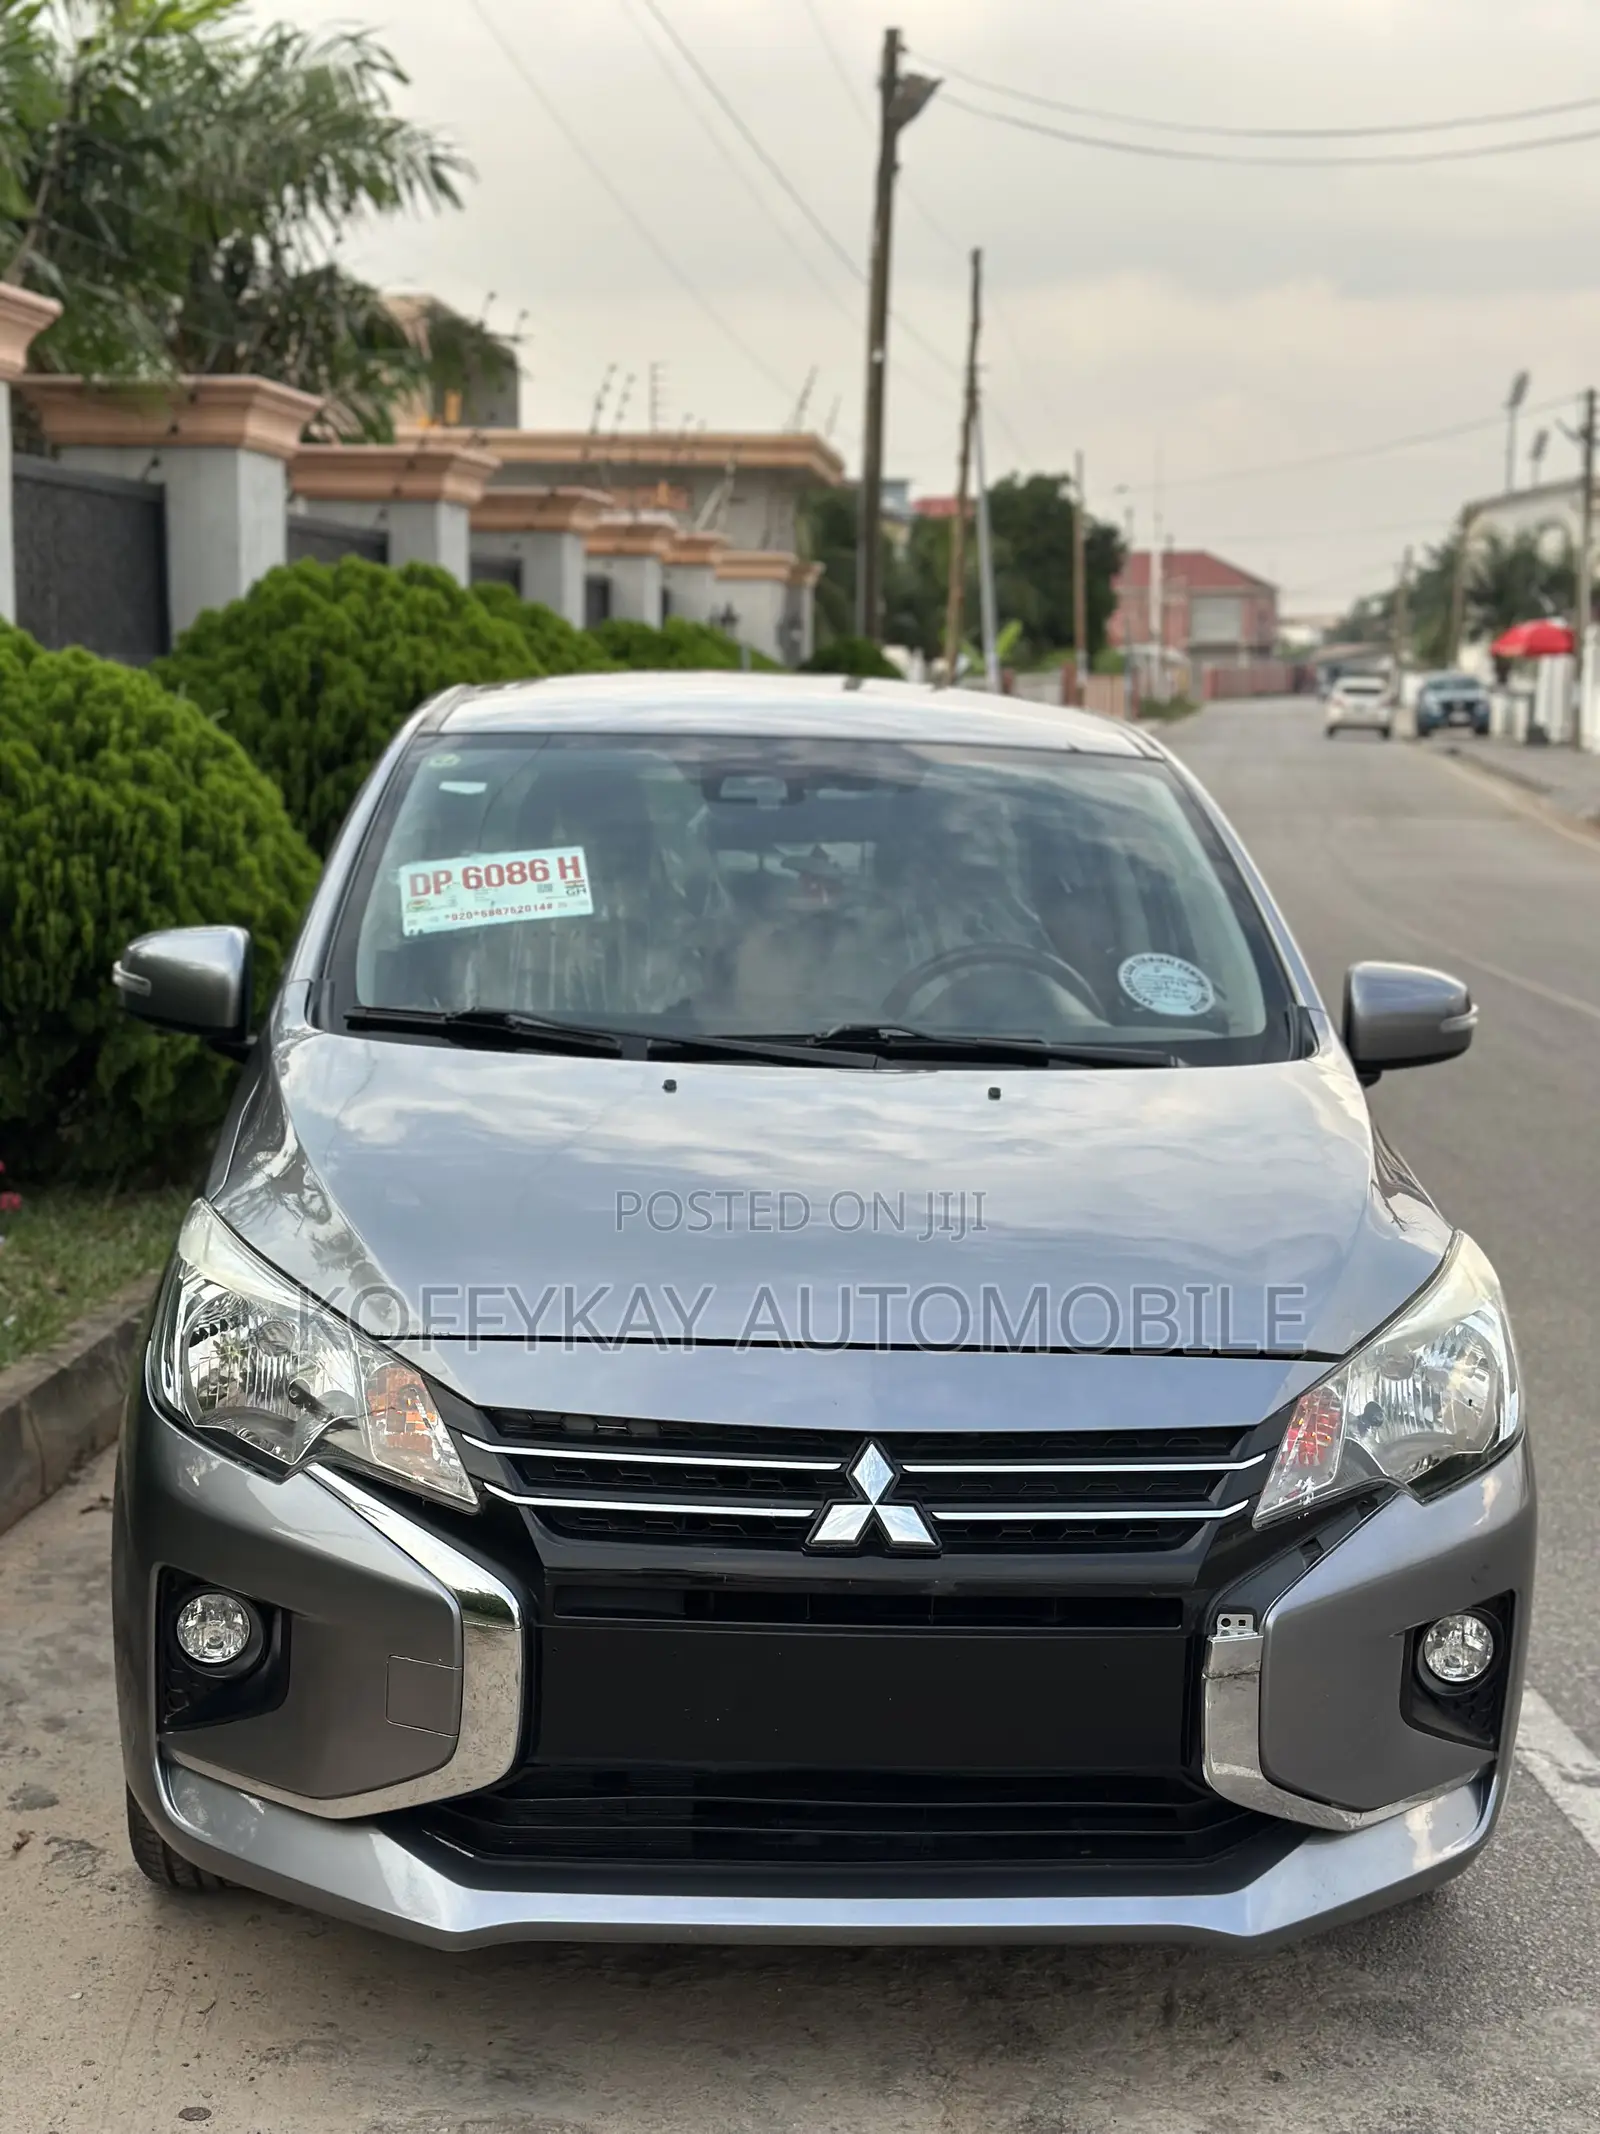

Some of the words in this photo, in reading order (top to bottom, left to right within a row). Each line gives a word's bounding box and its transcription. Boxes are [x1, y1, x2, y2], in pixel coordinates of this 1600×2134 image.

[409, 871, 453, 897] DP
[461, 859, 550, 890] 6086
[557, 856, 582, 880] H
